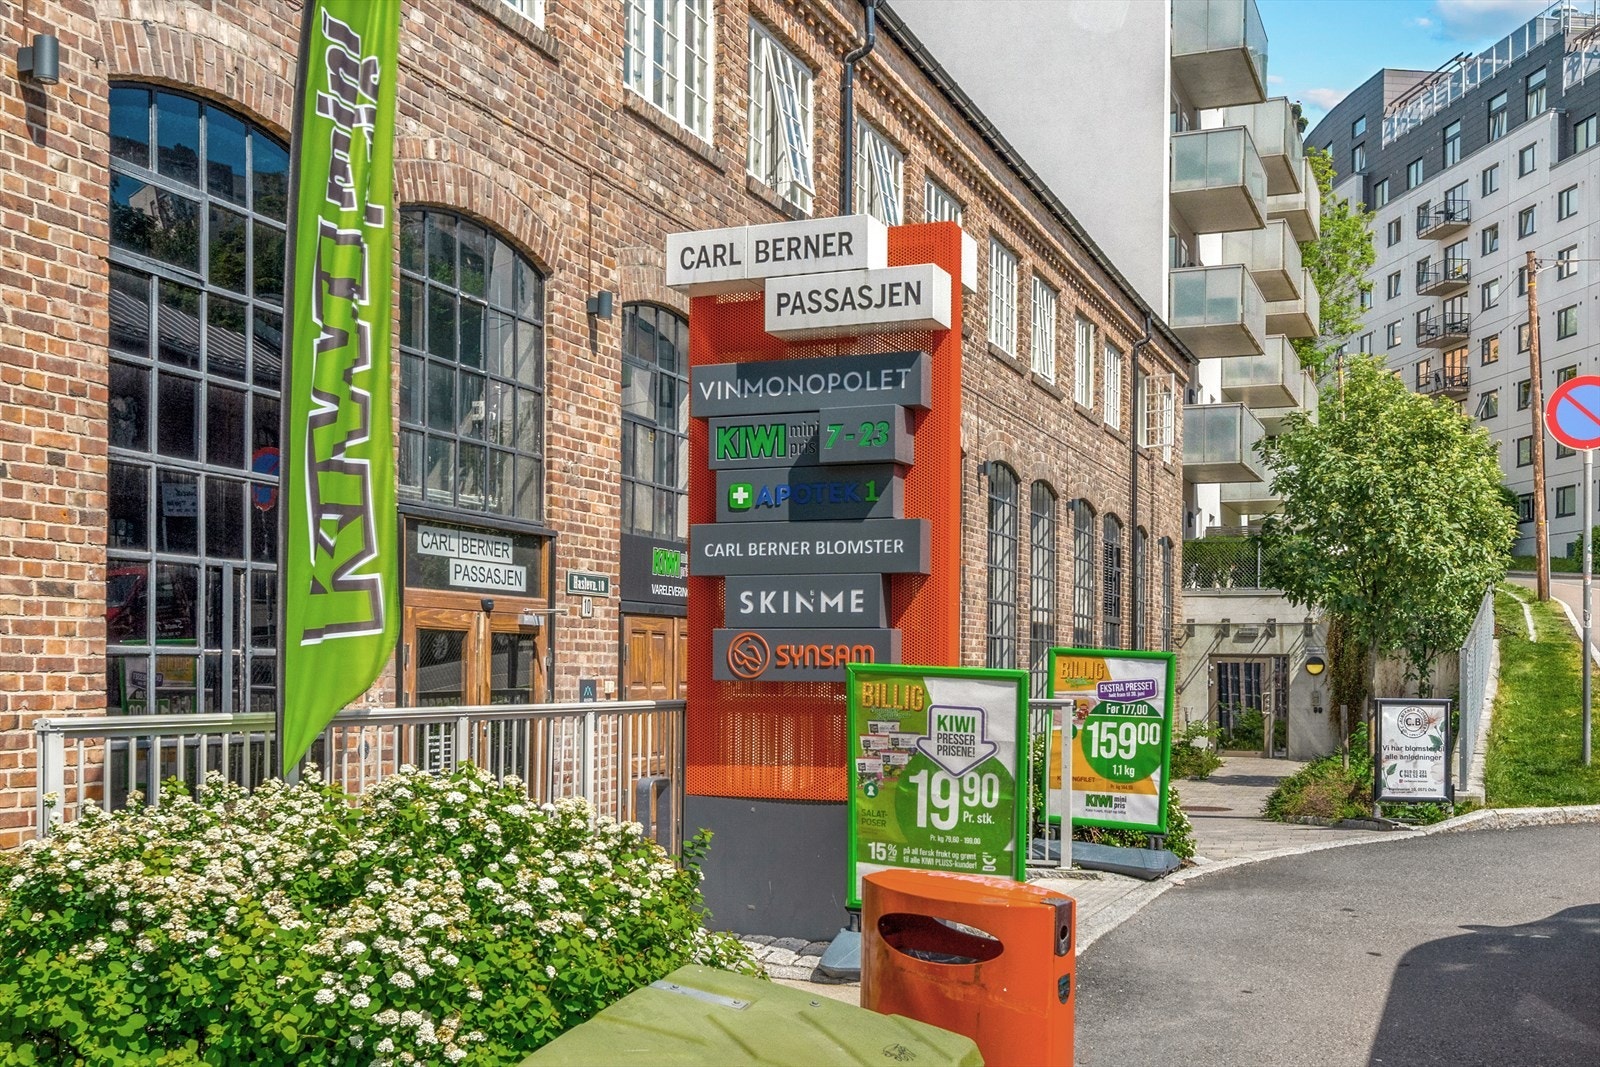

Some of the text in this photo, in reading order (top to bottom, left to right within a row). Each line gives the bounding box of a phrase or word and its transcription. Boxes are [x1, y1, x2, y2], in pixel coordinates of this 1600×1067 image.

[680, 231, 853, 271] CARL BERNER
[776, 280, 922, 317] PASSASJEN
[699, 368, 911, 400] VINMONOPOLET
[716, 423, 786, 461] KIWI
[788, 420, 819, 438] mini
[788, 439, 816, 459] pris
[755, 479, 879, 509] APOTEK 1
[420, 531, 510, 559] CARL BERNER
[704, 539, 904, 558] CARL BERNER BLOMSTER
[652, 546, 680, 579] KIWI
[454, 563, 523, 588] PASSASJEN
[651, 583, 688, 598] VARELEVERIN
[584, 598, 591, 615] 10
[775, 644, 875, 667] SYNSAM
[1060, 661, 1105, 681] BILLIG
[1100, 681, 1154, 693] EKSTRA PRESSET
[862, 682, 925, 713] BILLIG
[1106, 703, 1148, 716] Før 177,00
[937, 714, 976, 733] KIWI
[1405, 717, 1421, 726] C.B
[937, 732, 976, 746] PRESSER
[937, 744, 976, 758] PRISENE!
[1399, 754, 1442, 762] anledninger
[1112, 764, 1135, 778] 1,1 kg
[1057, 775, 1096, 783] KNGFILET
[1085, 793, 1113, 808] KIWI
[861, 808, 888, 818] SALAT-
[963, 811, 995, 825] Pr. stk.
[861, 817, 887, 828] POSER
[938, 835, 944, 843] kg
[903, 847, 910, 856] på
[919, 848, 934, 857] fersk
[935, 850, 951, 858] frukt
[951, 852, 959, 860] og
[960, 853, 977, 861] grønt
[910, 856, 920, 864] alle
[922, 857, 934, 865] KIWI
[935, 858, 977, 870] PLUSS-kunder!
